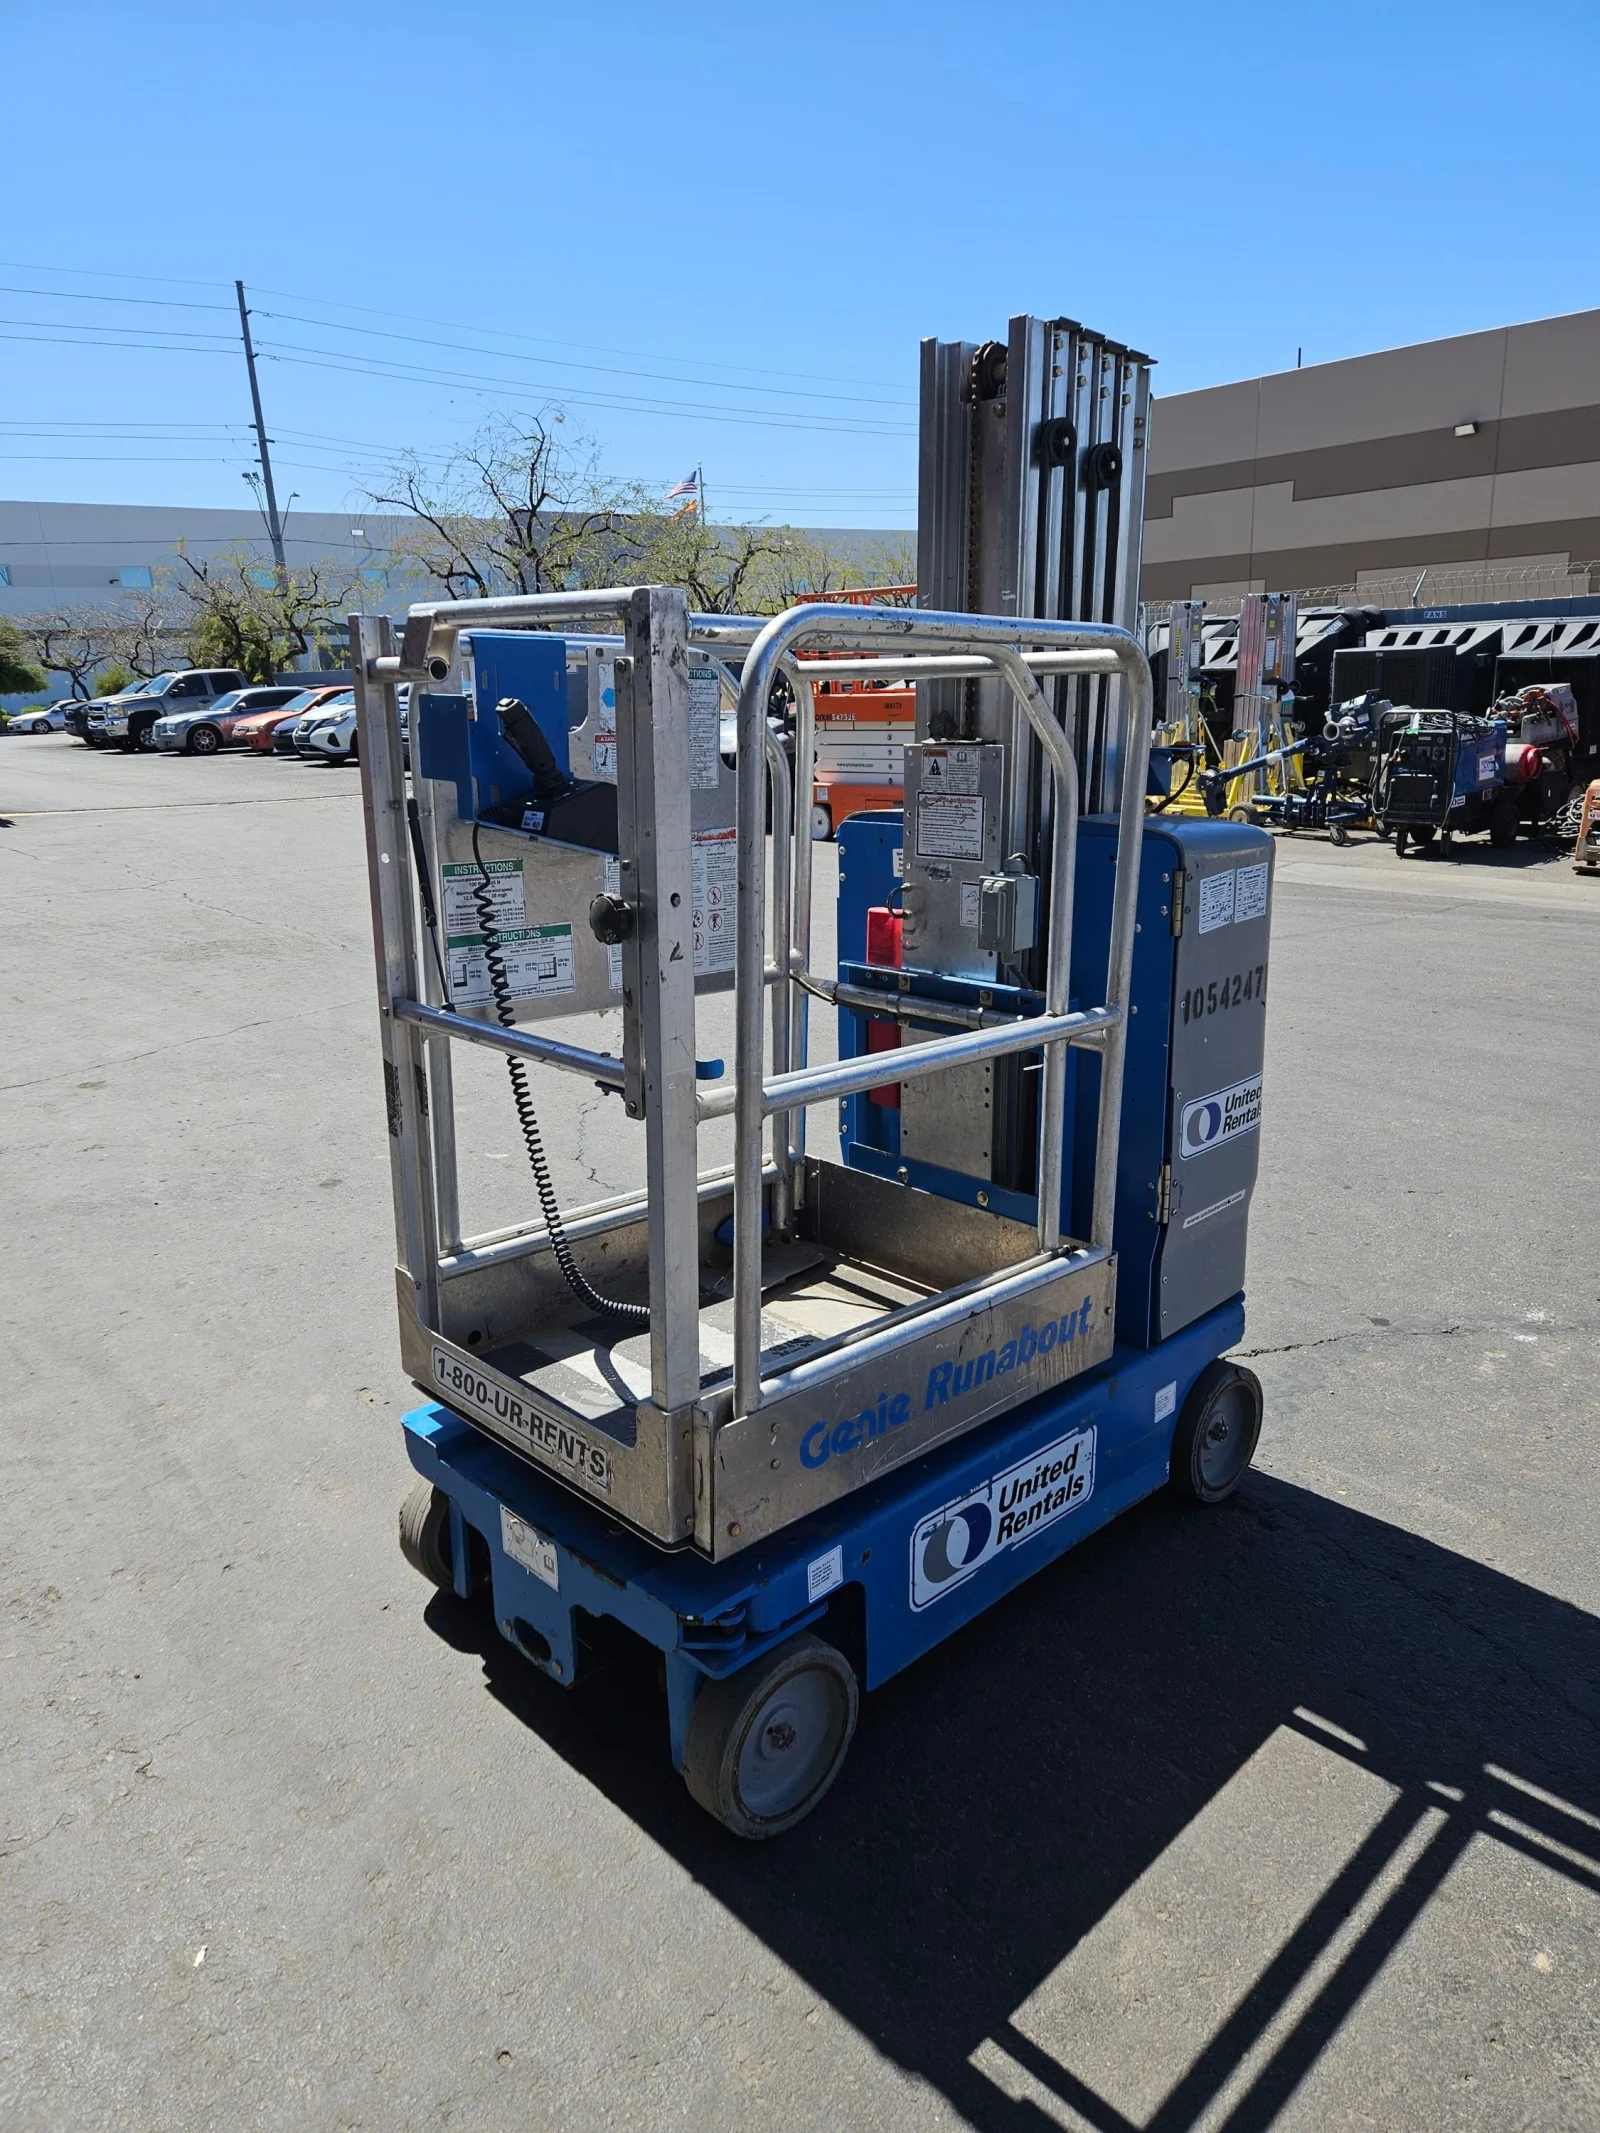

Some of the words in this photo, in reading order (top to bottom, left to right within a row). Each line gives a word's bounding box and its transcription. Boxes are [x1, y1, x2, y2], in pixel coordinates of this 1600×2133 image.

[454, 862, 514, 875] INSTRCTIONS
[488, 929, 541, 942] NSTRUCTIONS
[1183, 963, 1267, 1025] 1054247
[1225, 1080, 1262, 1113] United
[800, 1393, 910, 1469] Genie
[925, 1295, 1092, 1412] Runabout
[437, 1357, 607, 1478] 1-800-UR-RENTS
[996, 1474, 1084, 1546] Rentals
[999, 1443, 1080, 1513] United
